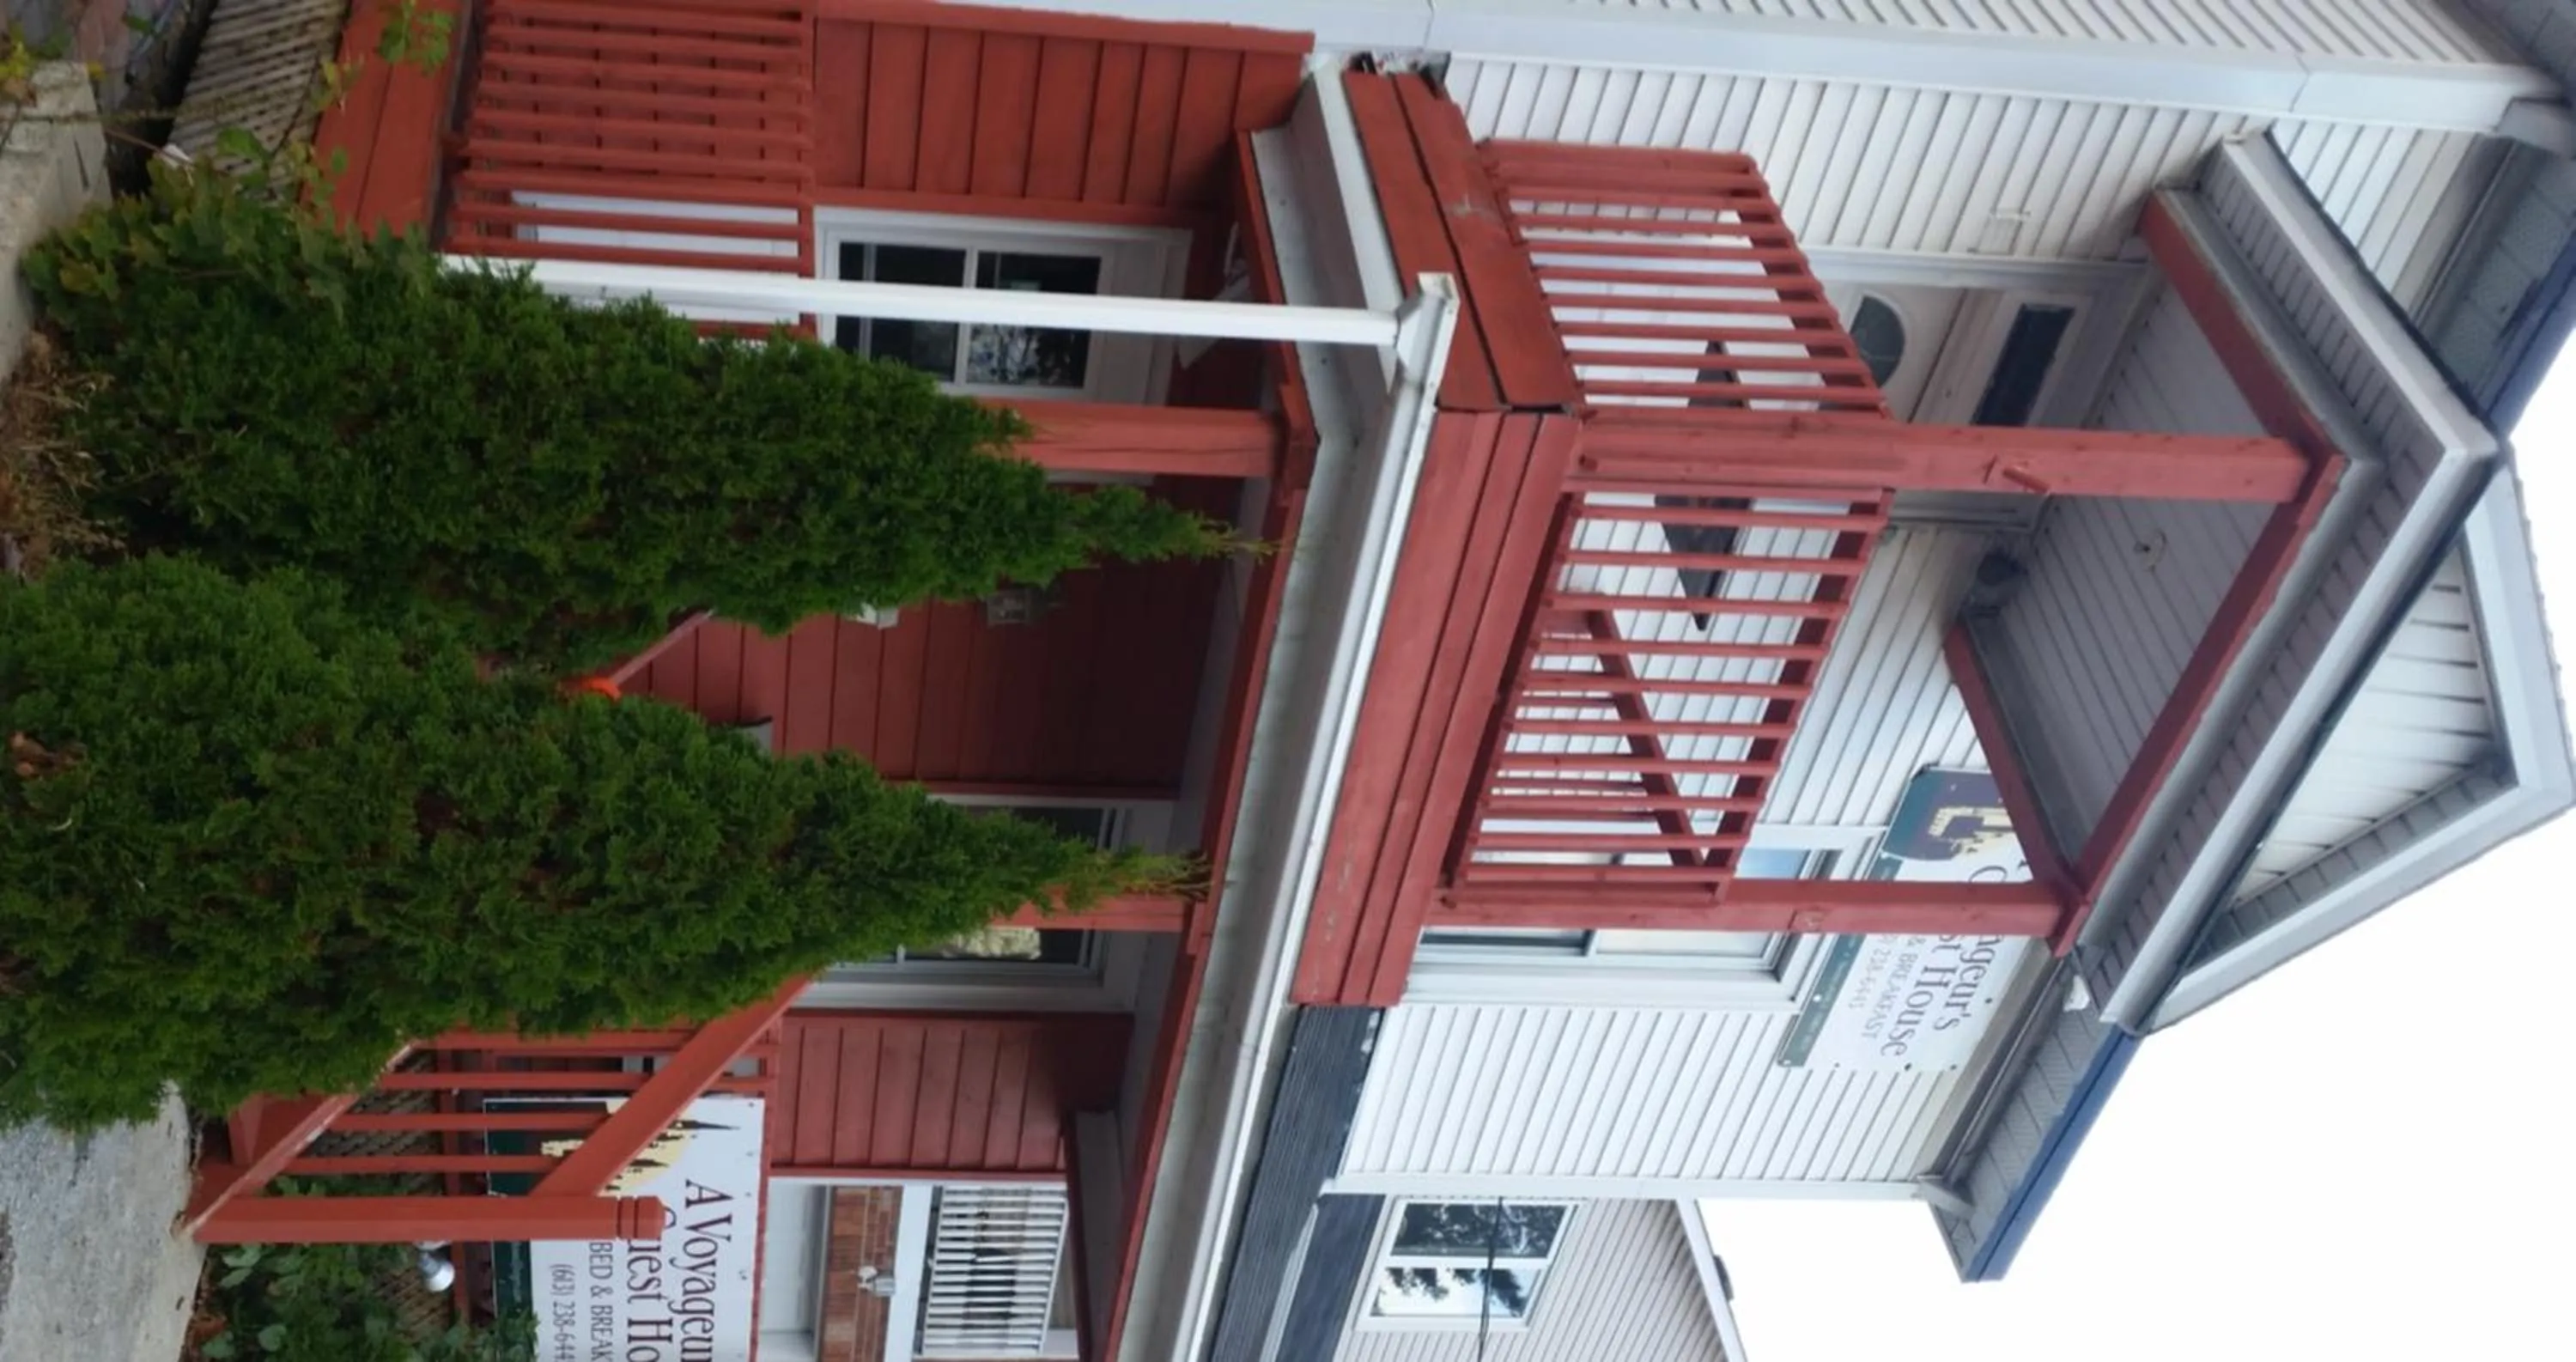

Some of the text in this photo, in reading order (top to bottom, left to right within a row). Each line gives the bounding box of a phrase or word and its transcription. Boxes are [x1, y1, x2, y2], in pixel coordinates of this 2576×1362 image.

[1862, 953, 1918, 1040] BREAKFAST
[1880, 966, 1958, 1056] House
[1933, 935, 2004, 1031] ageur's
[685, 1179, 734, 1209] A
[589, 1242, 613, 1280] BED
[590, 1285, 613, 1298] &
[627, 1207, 677, 1304] uest
[550, 1264, 576, 1362] (613) 238-644
